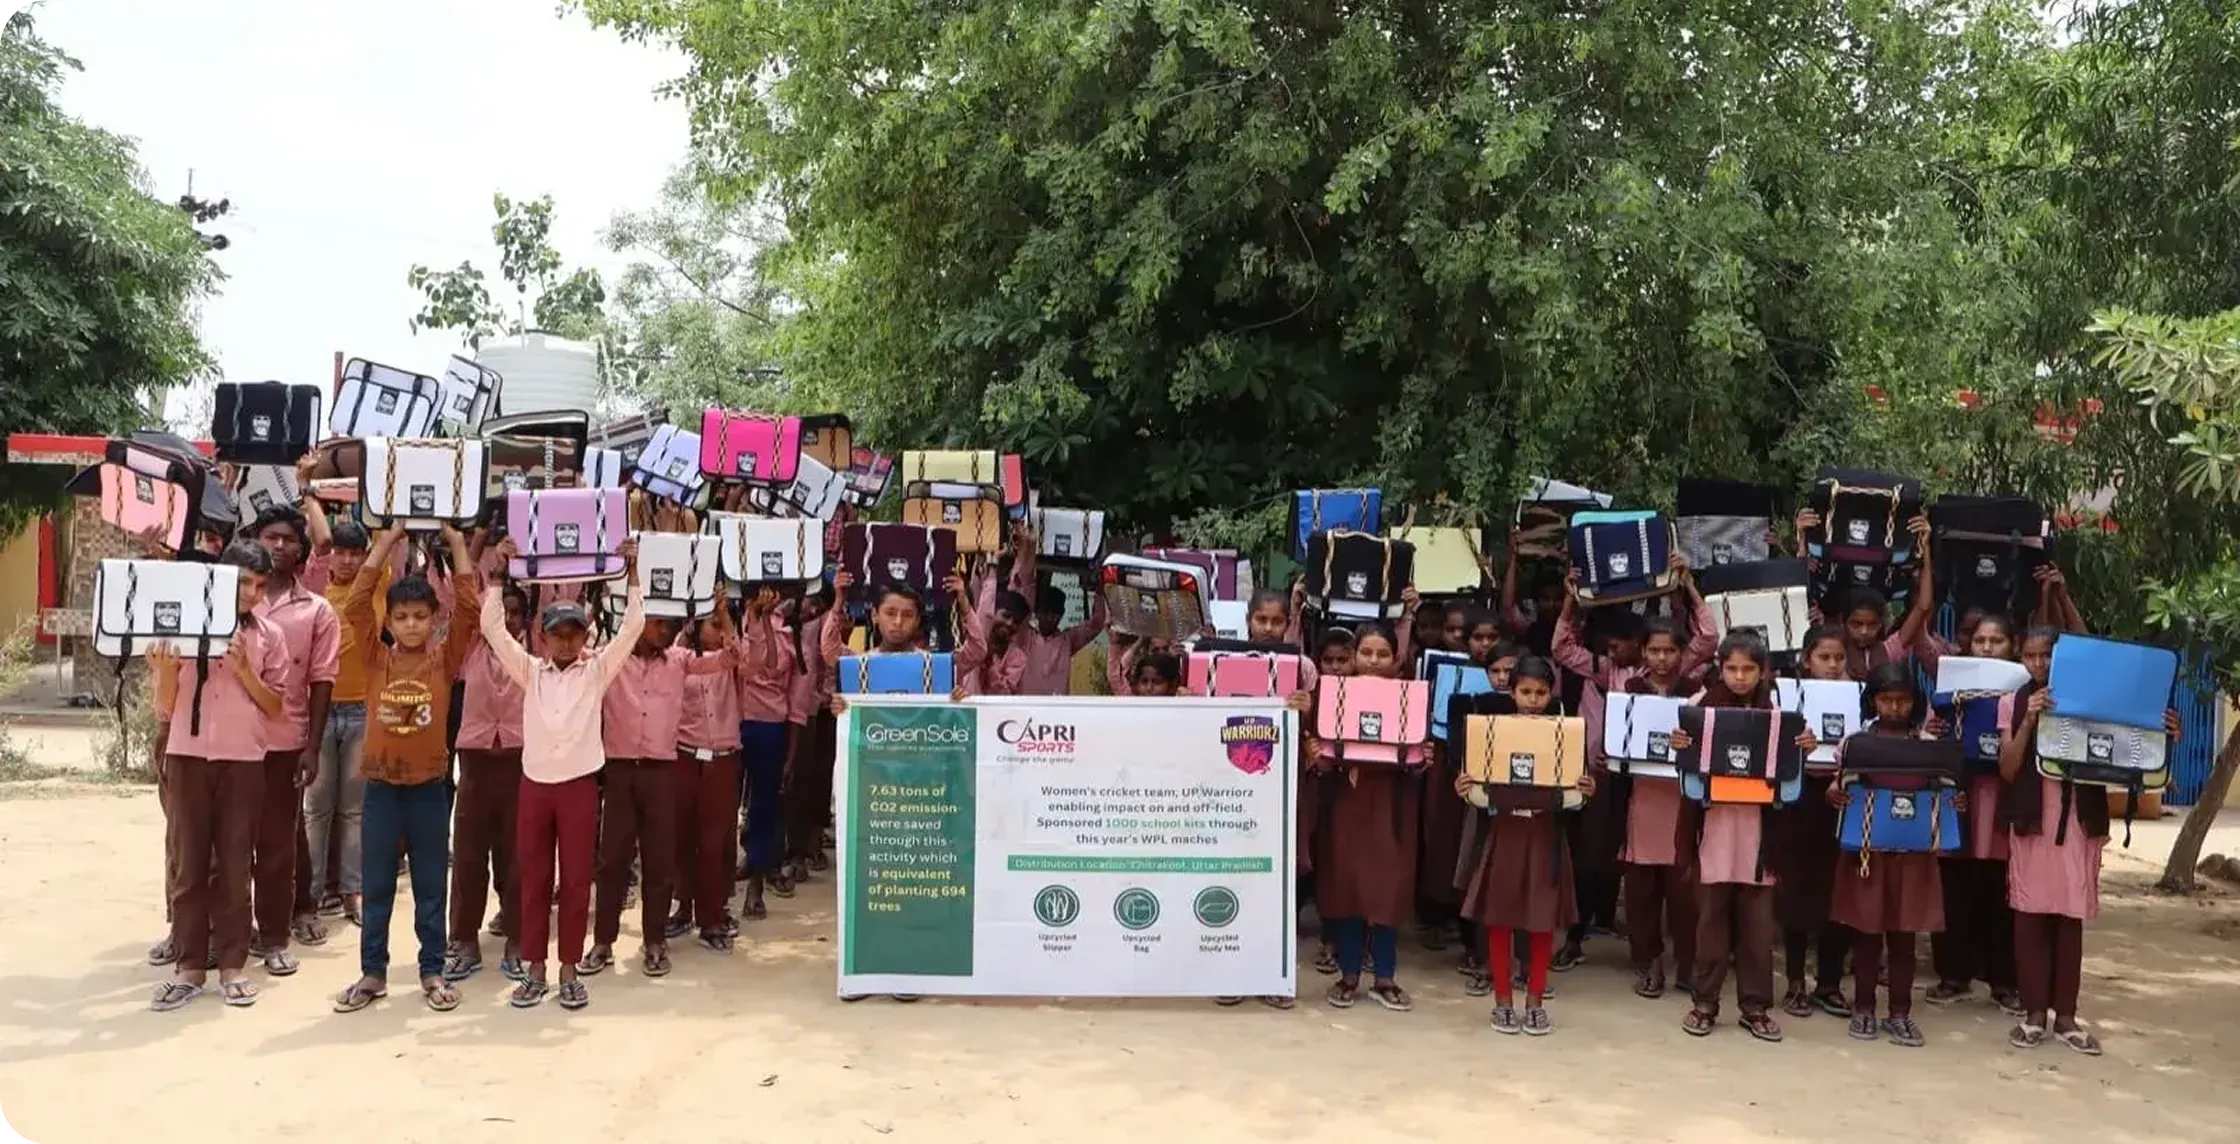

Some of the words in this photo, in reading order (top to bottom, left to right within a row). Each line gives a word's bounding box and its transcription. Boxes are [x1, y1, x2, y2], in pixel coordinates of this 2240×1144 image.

[415, 704, 432, 725] 3
[866, 723, 969, 744] GreenSole
[997, 717, 1075, 744] CAPRI
[1222, 725, 1278, 741] WARRIORZ
[1017, 741, 1075, 753] SPORTS
[869, 785, 898, 796] 7.63
[900, 786, 929, 797] tons
[932, 785, 946, 797] of
[1041, 786, 1097, 796] Women's
[1100, 787, 1141, 797] cricket
[1144, 788, 1179, 798] team,
[1182, 788, 1199, 797] UP
[1202, 788, 1254, 798] Warriorz
[870, 802, 897, 812] CO2
[1048, 802, 1101, 814] enabling
[1103, 803, 1145, 814] impact
[1148, 804, 1164, 813] on
[1167, 804, 1190, 813] and
[870, 820, 900, 829] were
[903, 819, 941, 830] saved
[1037, 817, 1102, 829] Sponsored
[1105, 819, 1138, 828] 1000
[1142, 818, 1181, 829] school
[1184, 819, 1206, 829] kits
[1208, 819, 1257, 831] through
[869, 834, 919, 847] through
[923, 836, 947, 847] this
[1076, 834, 1099, 844] this
[1101, 834, 1138, 845] year's
[1141, 835, 1168, 845] WPL
[1171, 835, 1218, 845] maches
[869, 852, 917, 865] activity
[919, 852, 957, 863] which
[869, 868, 879, 878] is
[882, 868, 951, 880] equivalent
[868, 885, 882, 895] of
[884, 885, 939, 898] planting
[941, 886, 966, 896] 694
[868, 901, 901, 911] trees
